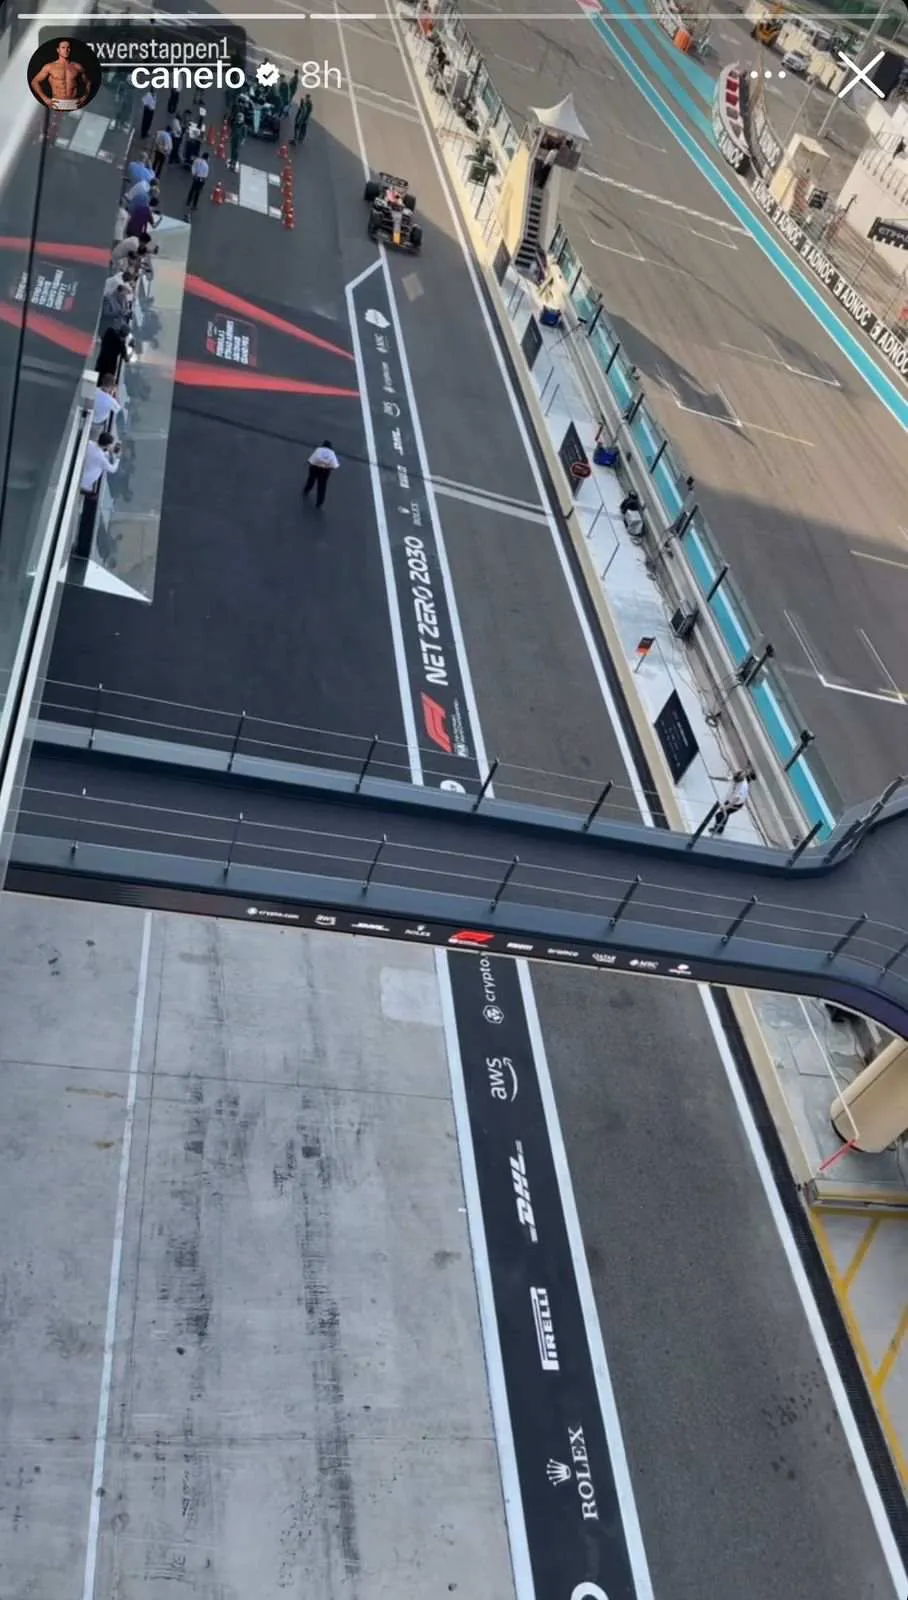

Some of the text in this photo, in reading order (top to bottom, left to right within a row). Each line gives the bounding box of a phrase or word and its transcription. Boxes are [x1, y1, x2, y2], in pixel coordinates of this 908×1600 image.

[806, 247, 835, 284] ADNOC
[840, 285, 871, 326] ADNOC
[403, 535, 449, 686] NET ZERO 2030
[486, 1057, 509, 1101] aws
[509, 1150, 537, 1232] DHL
[530, 1286, 560, 1371] PIRELLI
[568, 1425, 599, 1521] ROLEX
